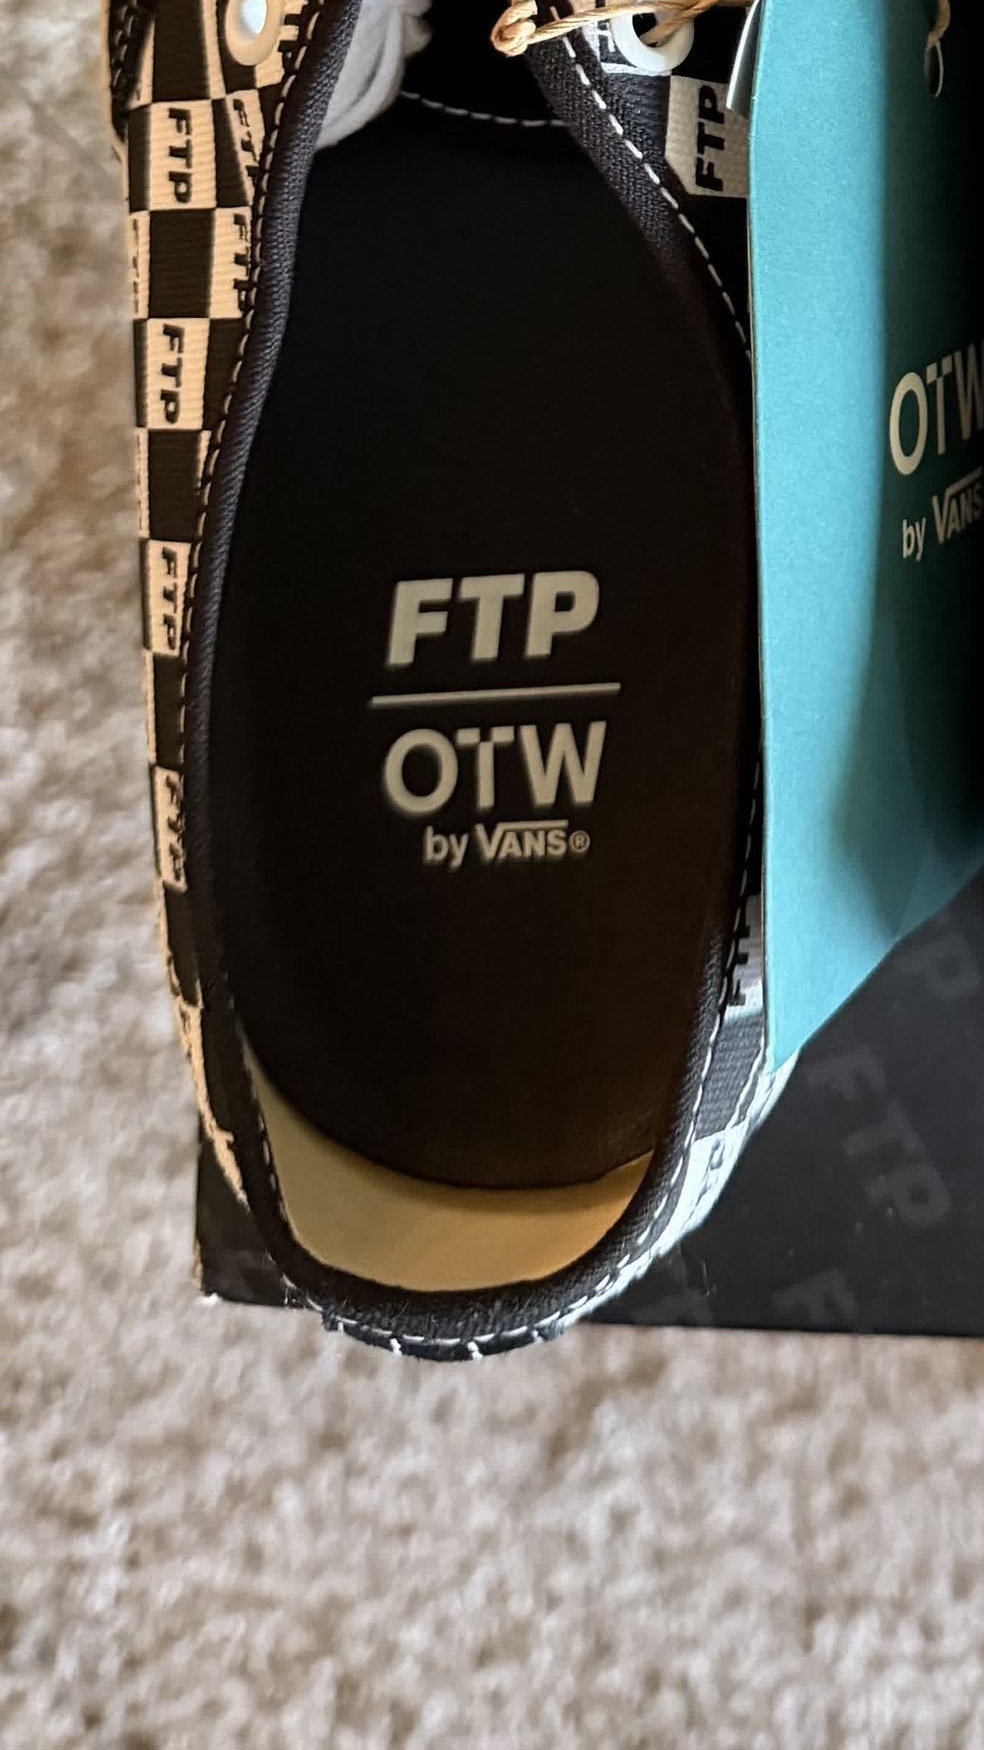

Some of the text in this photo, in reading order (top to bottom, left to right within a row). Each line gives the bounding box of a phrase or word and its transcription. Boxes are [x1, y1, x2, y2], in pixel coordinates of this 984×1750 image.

[168, 108, 192, 202] FTP
[695, 85, 726, 192] FTP
[160, 324, 184, 424] FTP
[903, 517, 927, 561] by
[386, 570, 600, 668] FTP
[383, 721, 607, 815] OTW
[424, 826, 469, 872] by
